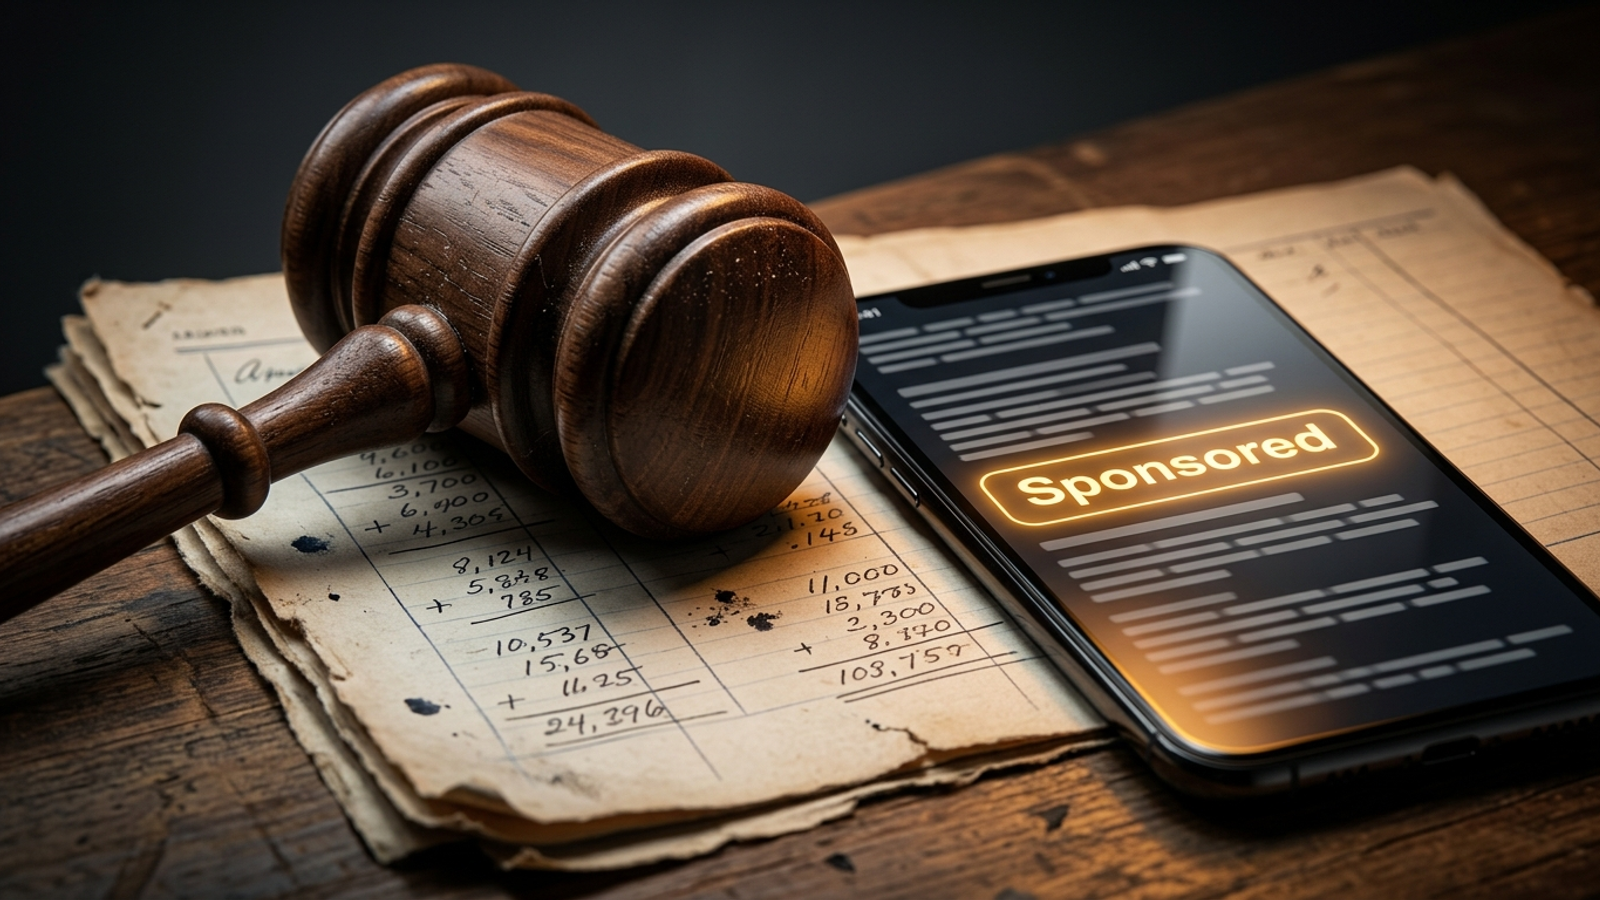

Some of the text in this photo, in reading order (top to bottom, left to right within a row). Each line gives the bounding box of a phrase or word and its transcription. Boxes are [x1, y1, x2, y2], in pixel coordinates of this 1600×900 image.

[1017, 423, 1338, 507] Sponsored
[388, 474, 477, 500] 3,700
[452, 545, 532, 575] 8,124
[808, 563, 899, 594] 11,000
[847, 602, 936, 632] 2,300
[497, 624, 591, 656] 10,537
[544, 699, 666, 736] 24,396
